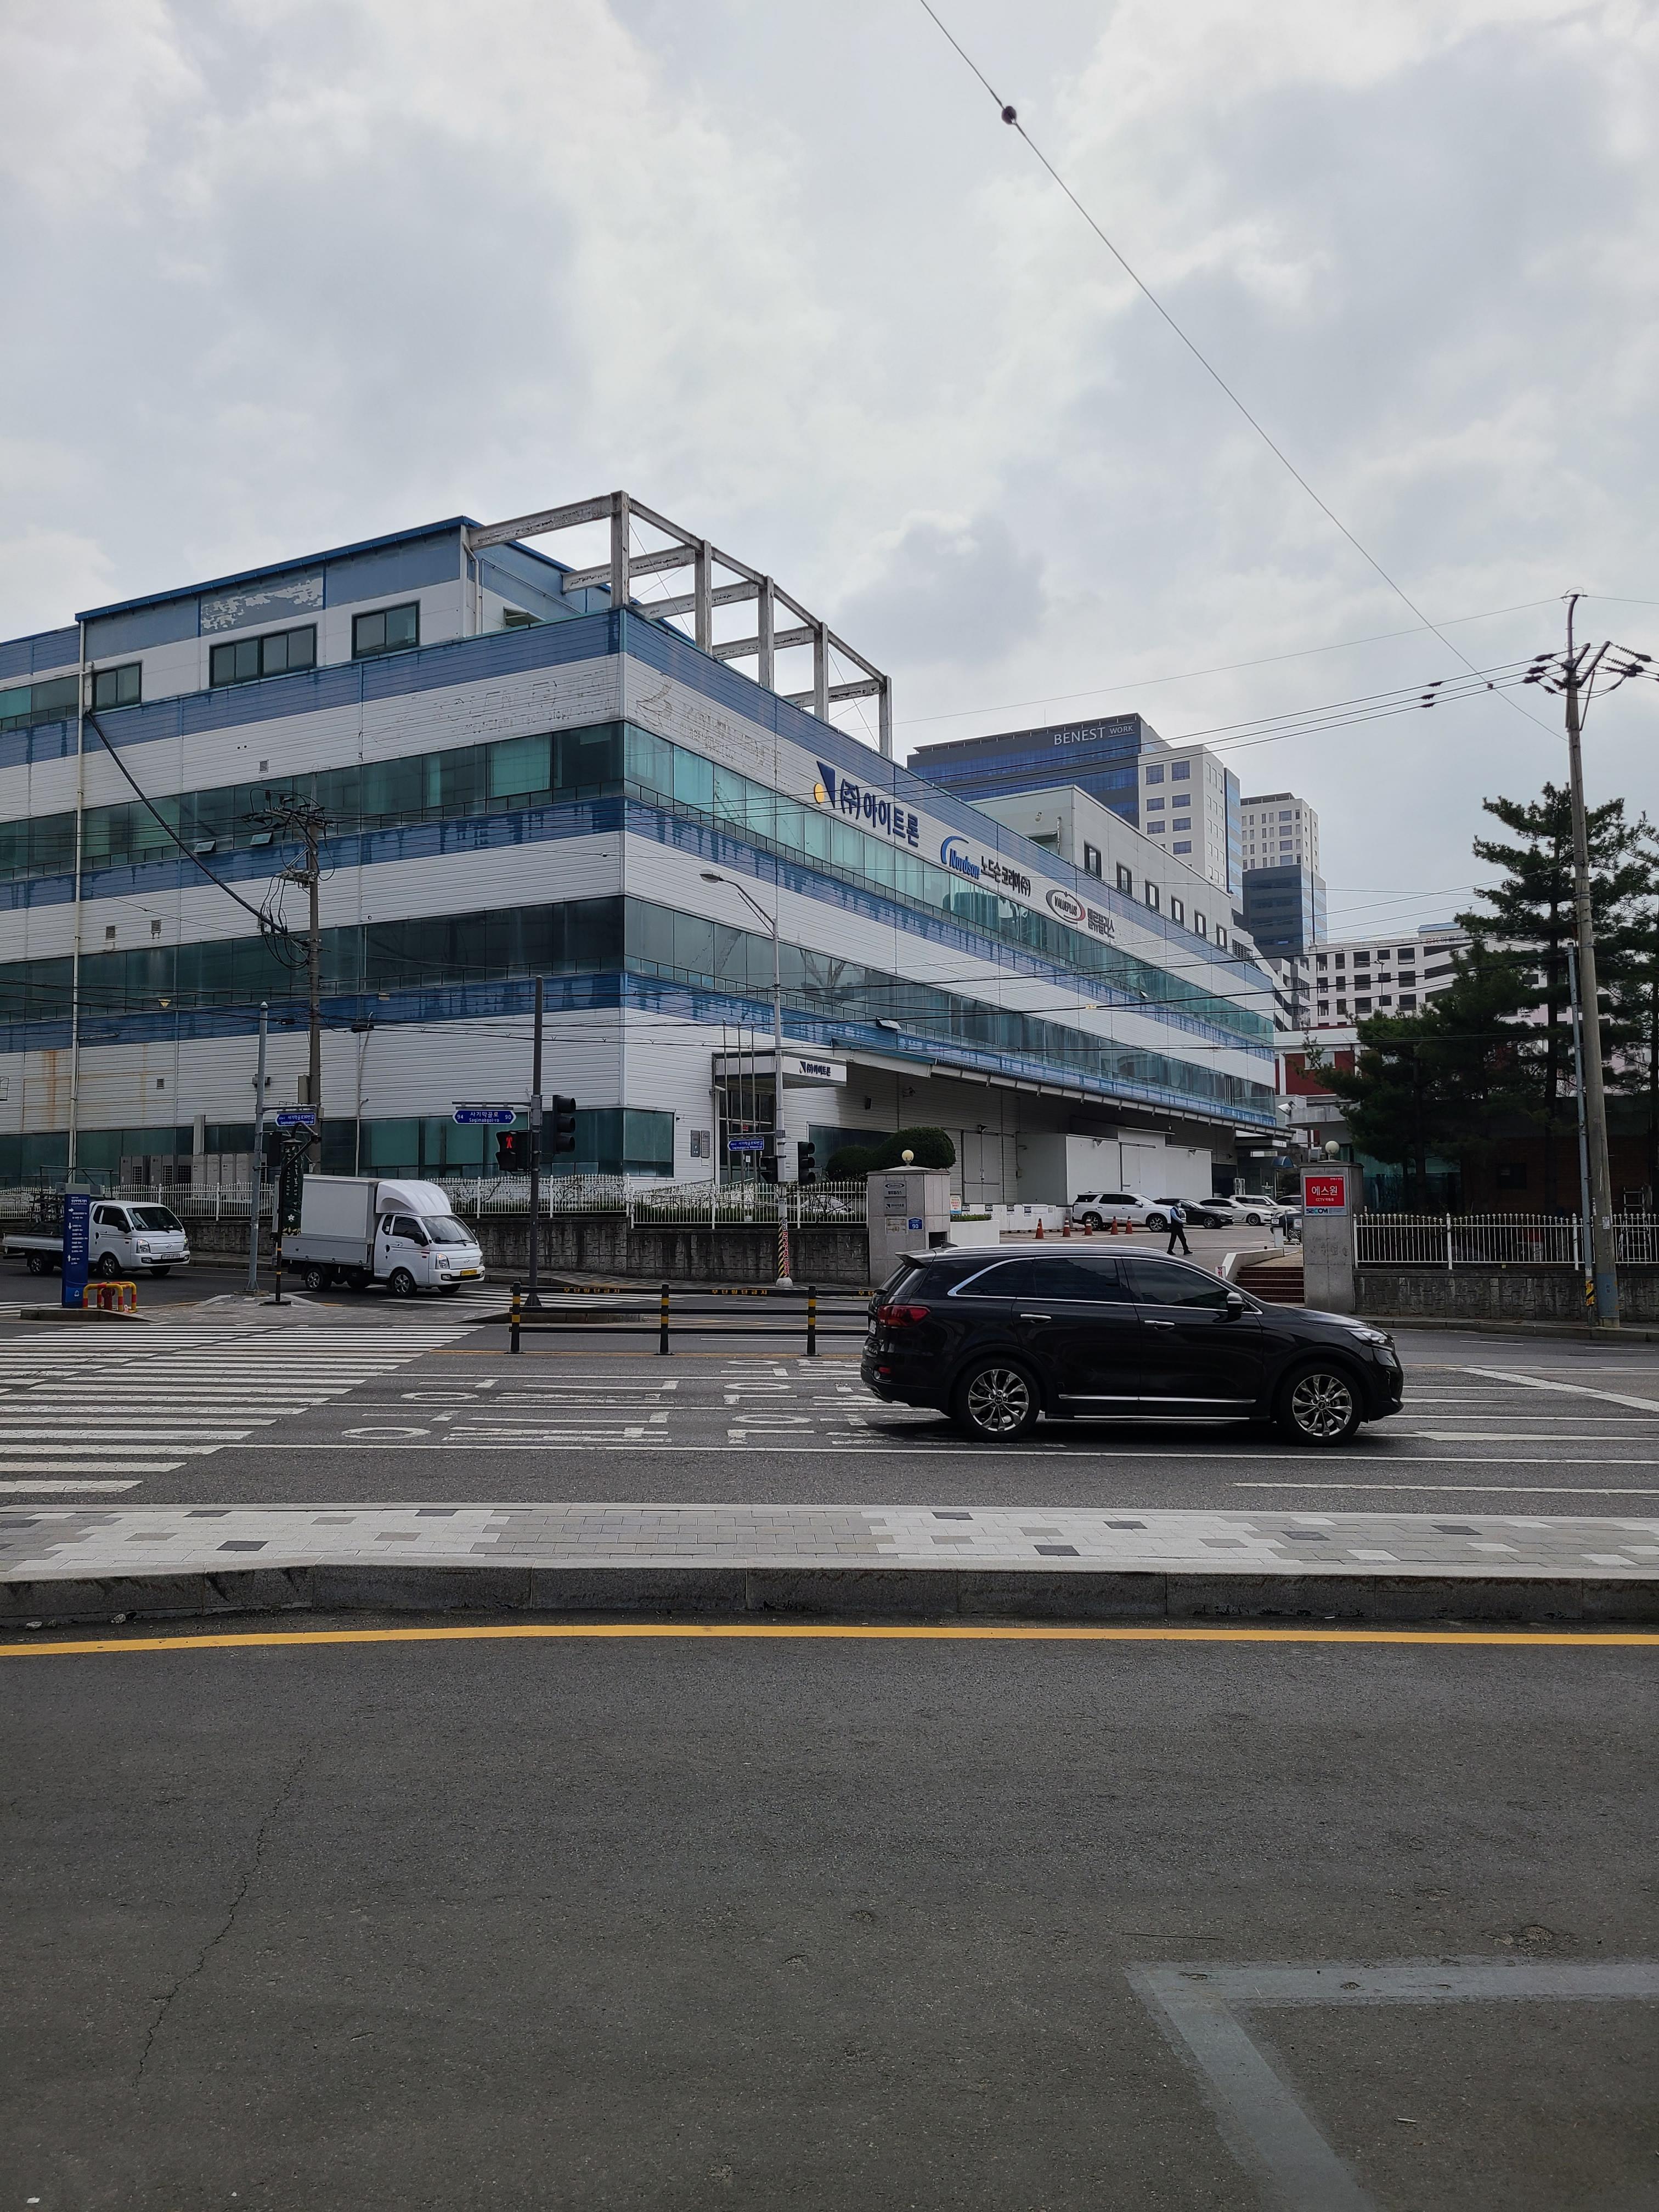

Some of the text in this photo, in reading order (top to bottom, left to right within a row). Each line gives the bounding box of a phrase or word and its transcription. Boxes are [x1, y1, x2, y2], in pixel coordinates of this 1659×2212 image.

[1054, 725, 1133, 745] BENEST WORK
[840, 778, 919, 847] (주)아이트론
[949, 848, 980, 879] Nordson
[1054, 895, 1077, 916] VALUEPLUS
[1311, 1186, 1338, 1196] 에스원
